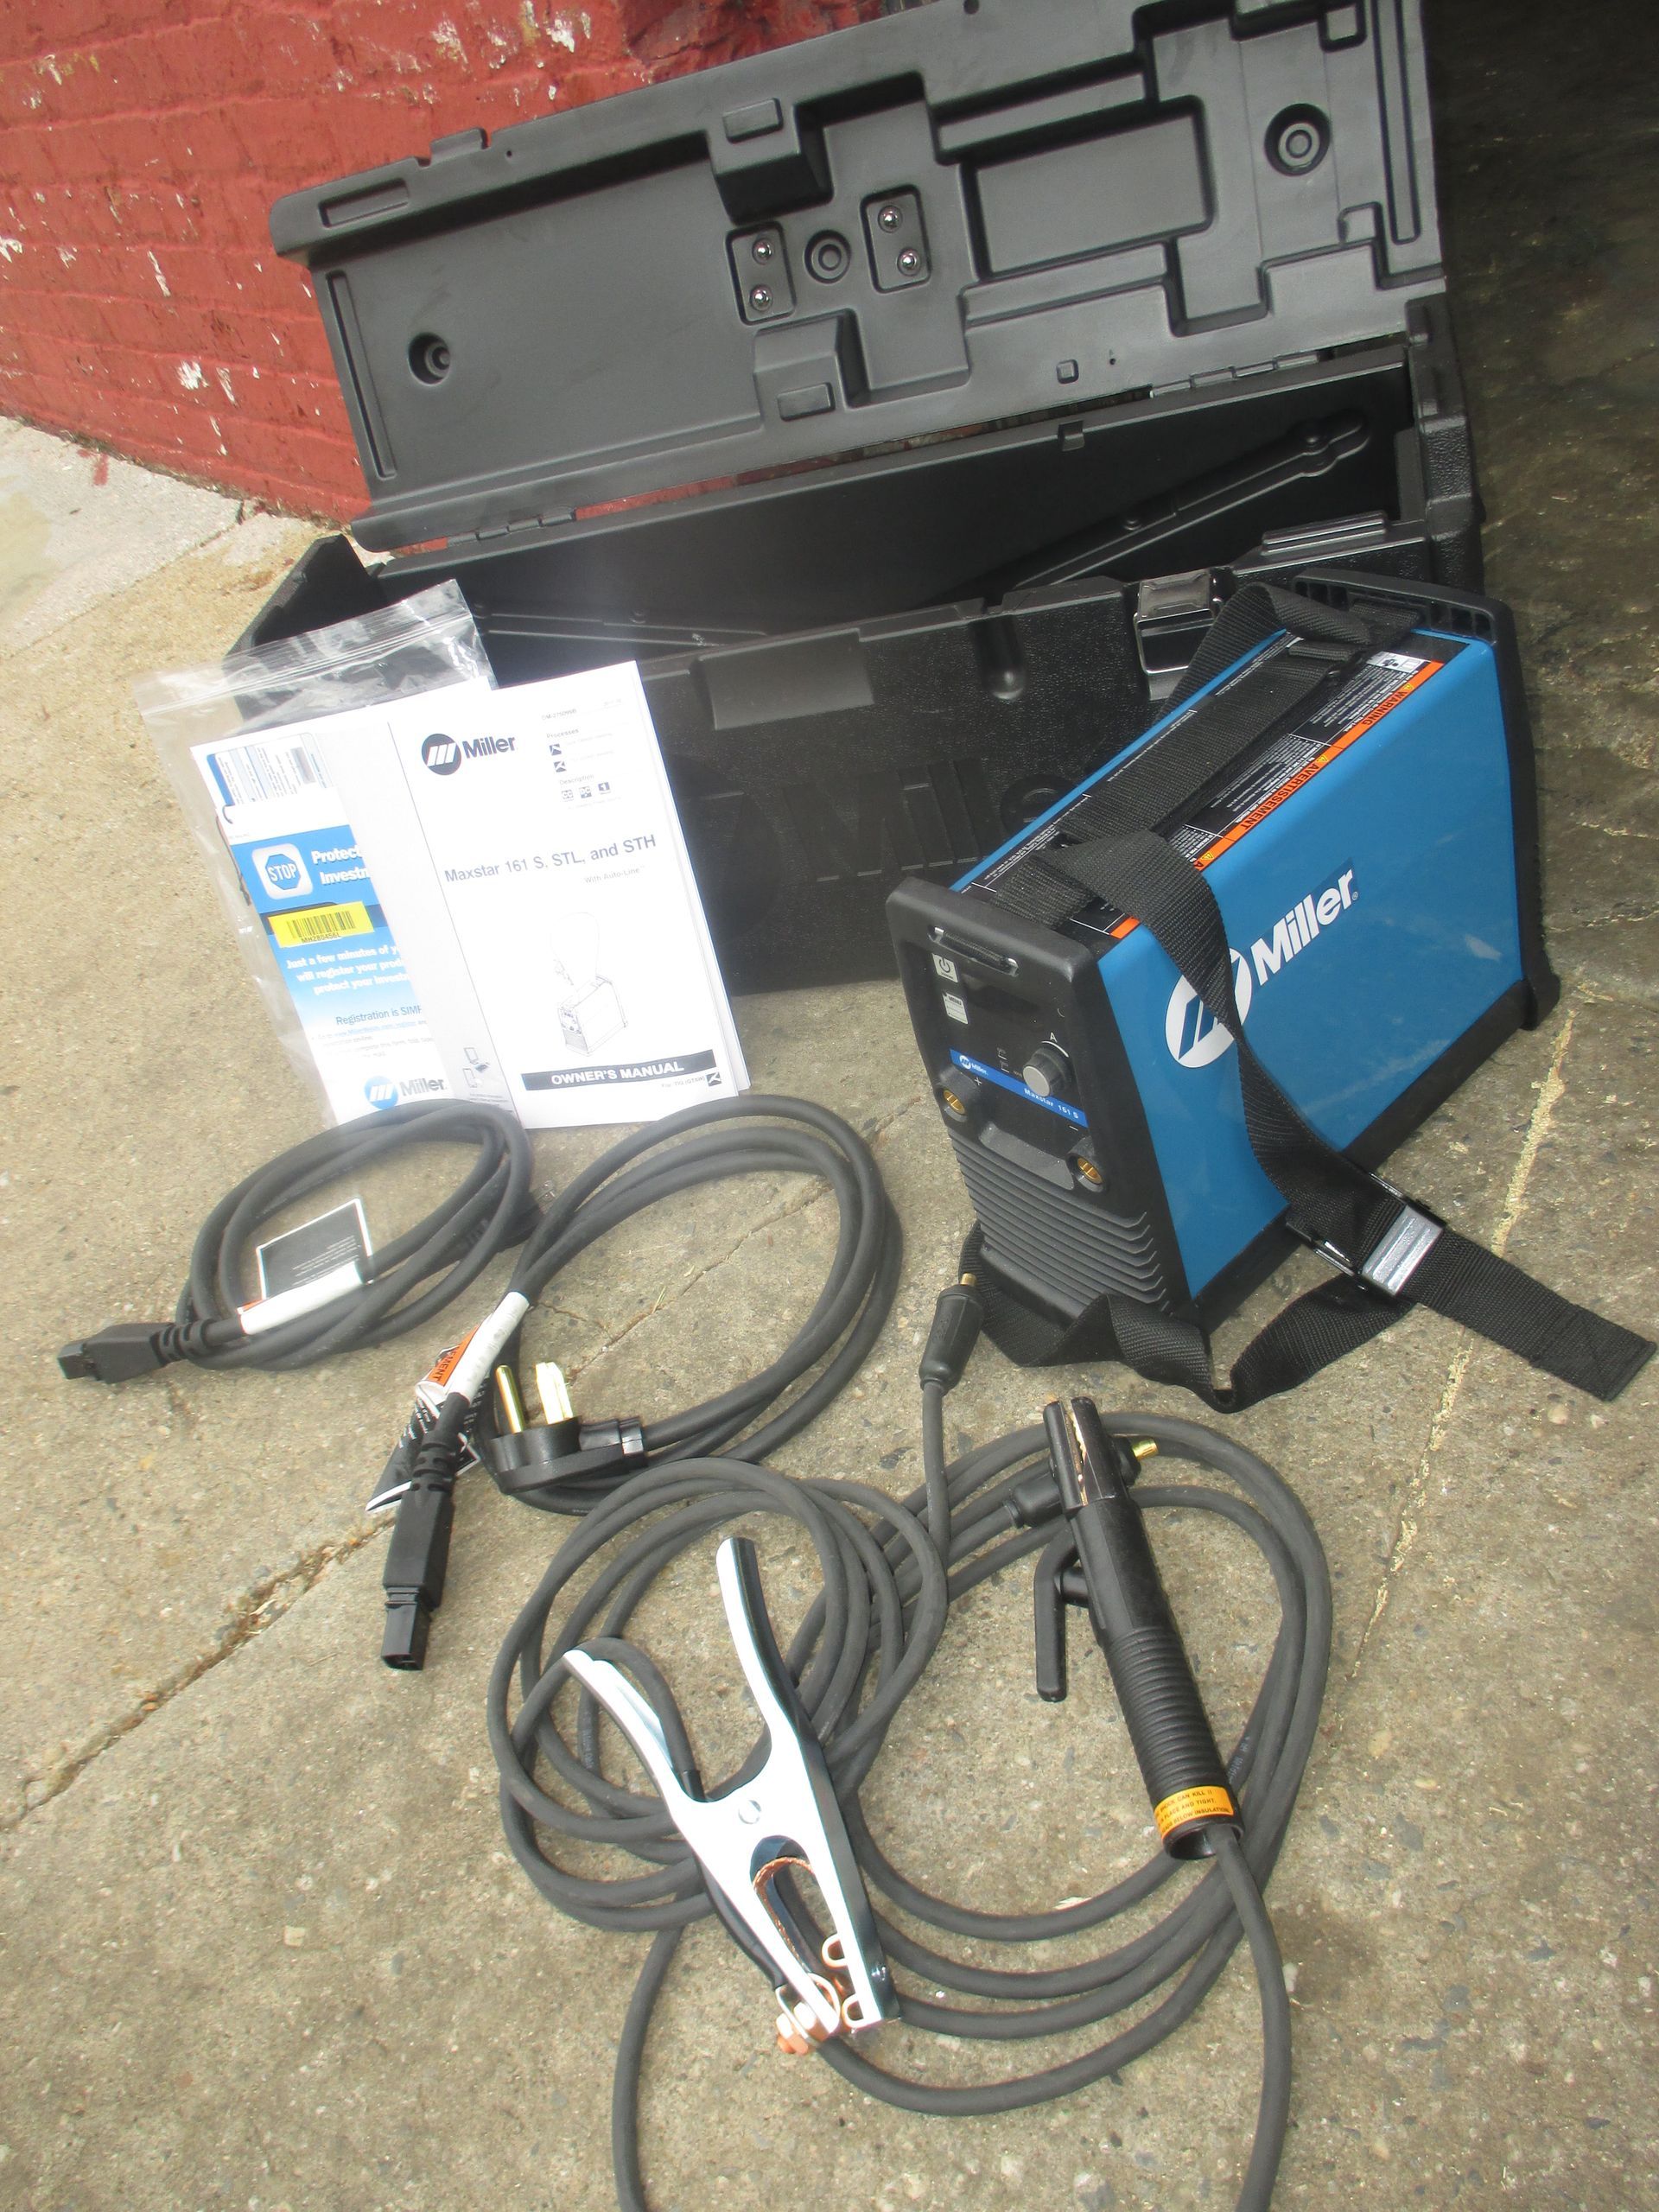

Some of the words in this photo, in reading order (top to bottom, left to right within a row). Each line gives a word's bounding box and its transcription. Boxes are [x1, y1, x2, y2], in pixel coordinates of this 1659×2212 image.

[1362, 691, 1408, 725] WARNING
[461, 734, 516, 760] Miller
[1240, 763, 1319, 830] AVERTISSEMENT
[444, 863, 499, 883] Maxstar
[505, 858, 528, 874] 161
[551, 851, 586, 868] STL,
[590, 843, 619, 861] and
[623, 835, 657, 854] STH
[268, 862, 298, 882] STOP
[584, 874, 601, 884] With
[1250, 869, 1353, 986] Miller
[287, 958, 308, 969] Just
[316, 954, 335, 963] few
[338, 948, 377, 961] minutes
[378, 945, 389, 955] of
[296, 971, 314, 982] will
[316, 965, 354, 980] register
[355, 962, 378, 975] your
[314, 979, 349, 995] protect
[352, 976, 372, 989] your
[336, 1008, 390, 1026] Registration
[391, 1008, 399, 1017] is
[1050, 1032, 1058, 1042] A
[551, 1067, 618, 1084] OWNER'S
[620, 1062, 684, 1079] MANUAL
[400, 1078, 445, 1096] Miller
[1024, 1087, 1054, 1107] Maxstar
[1058, 1104, 1071, 1116] 161
[1177, 1793, 1190, 1802] CAN
[1164, 1807, 1179, 1819] PLACE
[1173, 1812, 1192, 1822] BELOW
